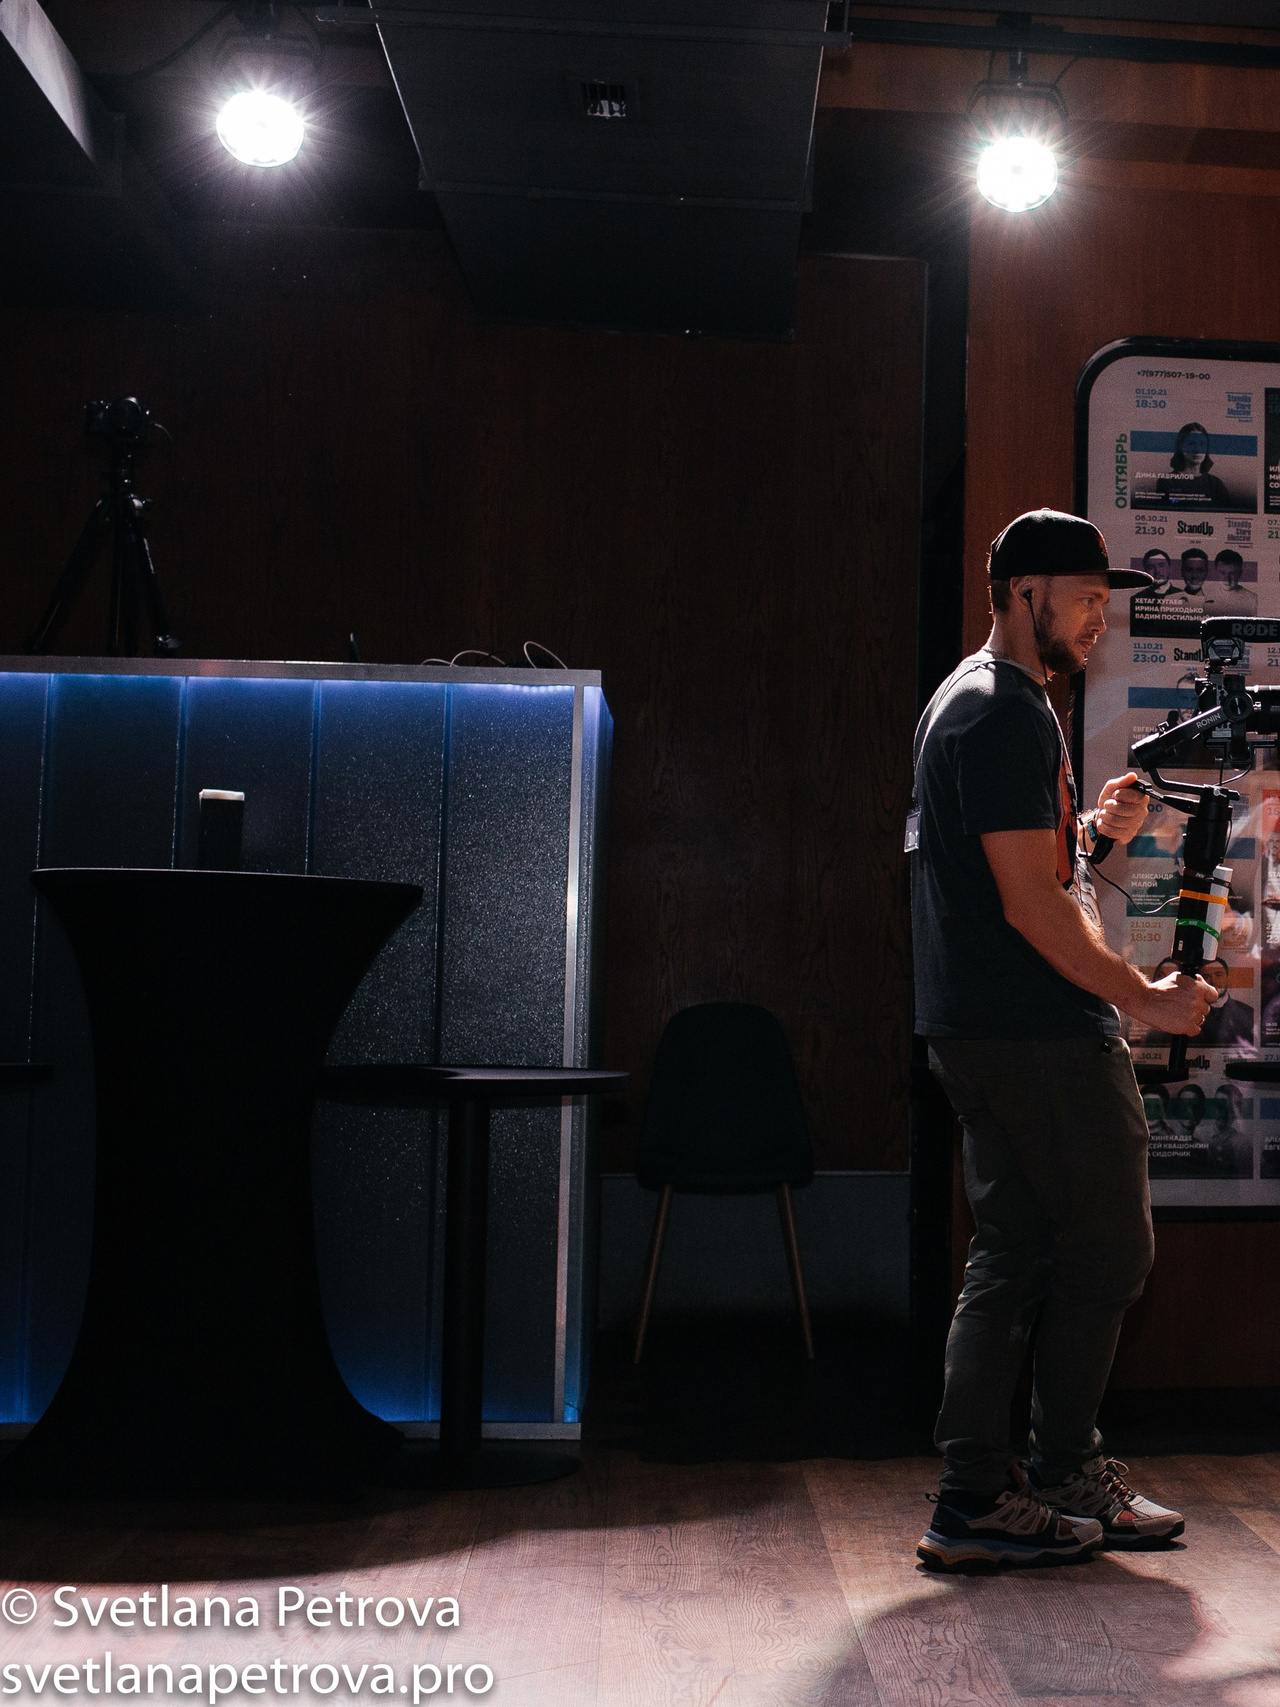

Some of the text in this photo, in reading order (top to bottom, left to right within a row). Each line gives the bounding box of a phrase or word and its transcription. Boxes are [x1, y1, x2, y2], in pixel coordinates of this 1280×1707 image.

[1136, 369, 1211, 380] +7(977)507-19-00
[1135, 388, 1167, 396] 01.10.21
[1135, 399, 1167, 409] 18:30
[1115, 432, 1128, 509] ОКТЯБРЬ
[1135, 471, 1194, 480] ДИМА ГАВРИЛОВ
[1135, 514, 1168, 522] 06.10.21
[1135, 526, 1165, 536] 21:30
[1177, 520, 1214, 537] StandUp
[1231, 622, 1278, 637] RØDE
[1133, 642, 1163, 650] 11.10.21
[1132, 653, 1166, 663] 23:00
[1195, 712, 1222, 729] RONIN
[1131, 873, 1174, 881] АЛЕКСАНДР
[1131, 880, 1158, 888] МАЛОЙ
[1130, 921, 1161, 929] 21.10.21
[1130, 933, 1161, 942] 18:30
